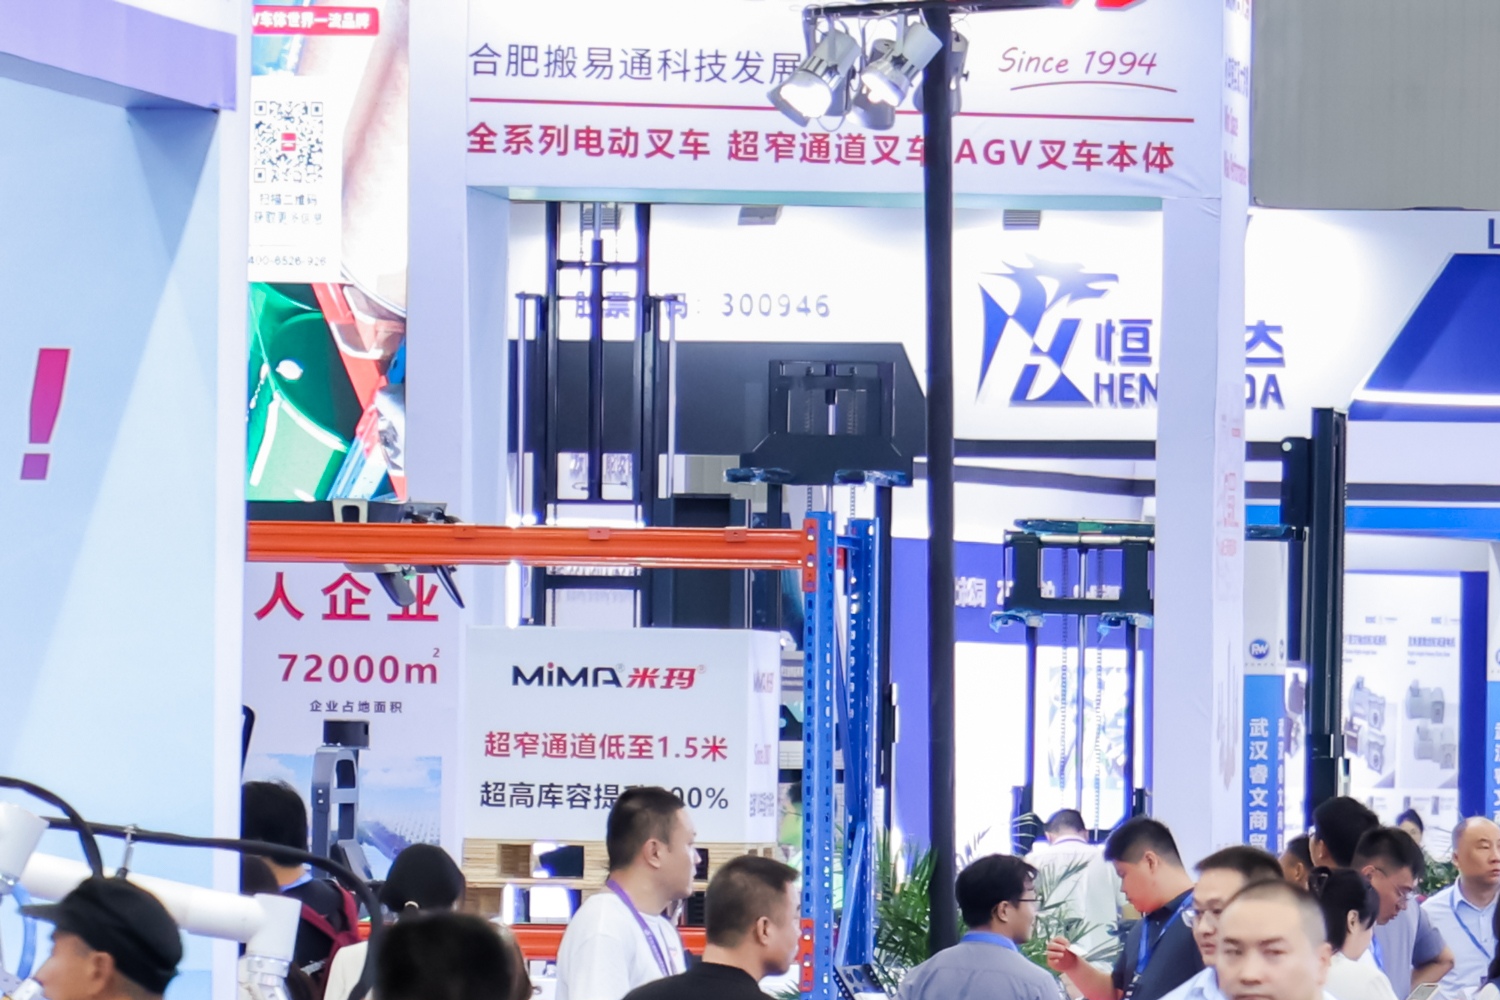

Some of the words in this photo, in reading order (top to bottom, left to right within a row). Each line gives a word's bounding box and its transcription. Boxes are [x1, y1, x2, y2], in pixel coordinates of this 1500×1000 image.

[998, 46, 1069, 74] Since
[1083, 50, 1158, 76] 1994
[466, 121, 711, 161] 全系列电动叉车
[954, 138, 1175, 174] AGV叉车本体
[721, 292, 831, 319] 300946
[1095, 318, 1286, 368] 恒达
[1094, 372, 1286, 409] HENDA
[253, 571, 439, 622] 人企业
[626, 666, 698, 691] 米玛
[309, 699, 403, 714] 企业占地面积
[483, 730, 729, 763] 超窄通道低至1.5米
[479, 780, 730, 810] 超高库容提00%
